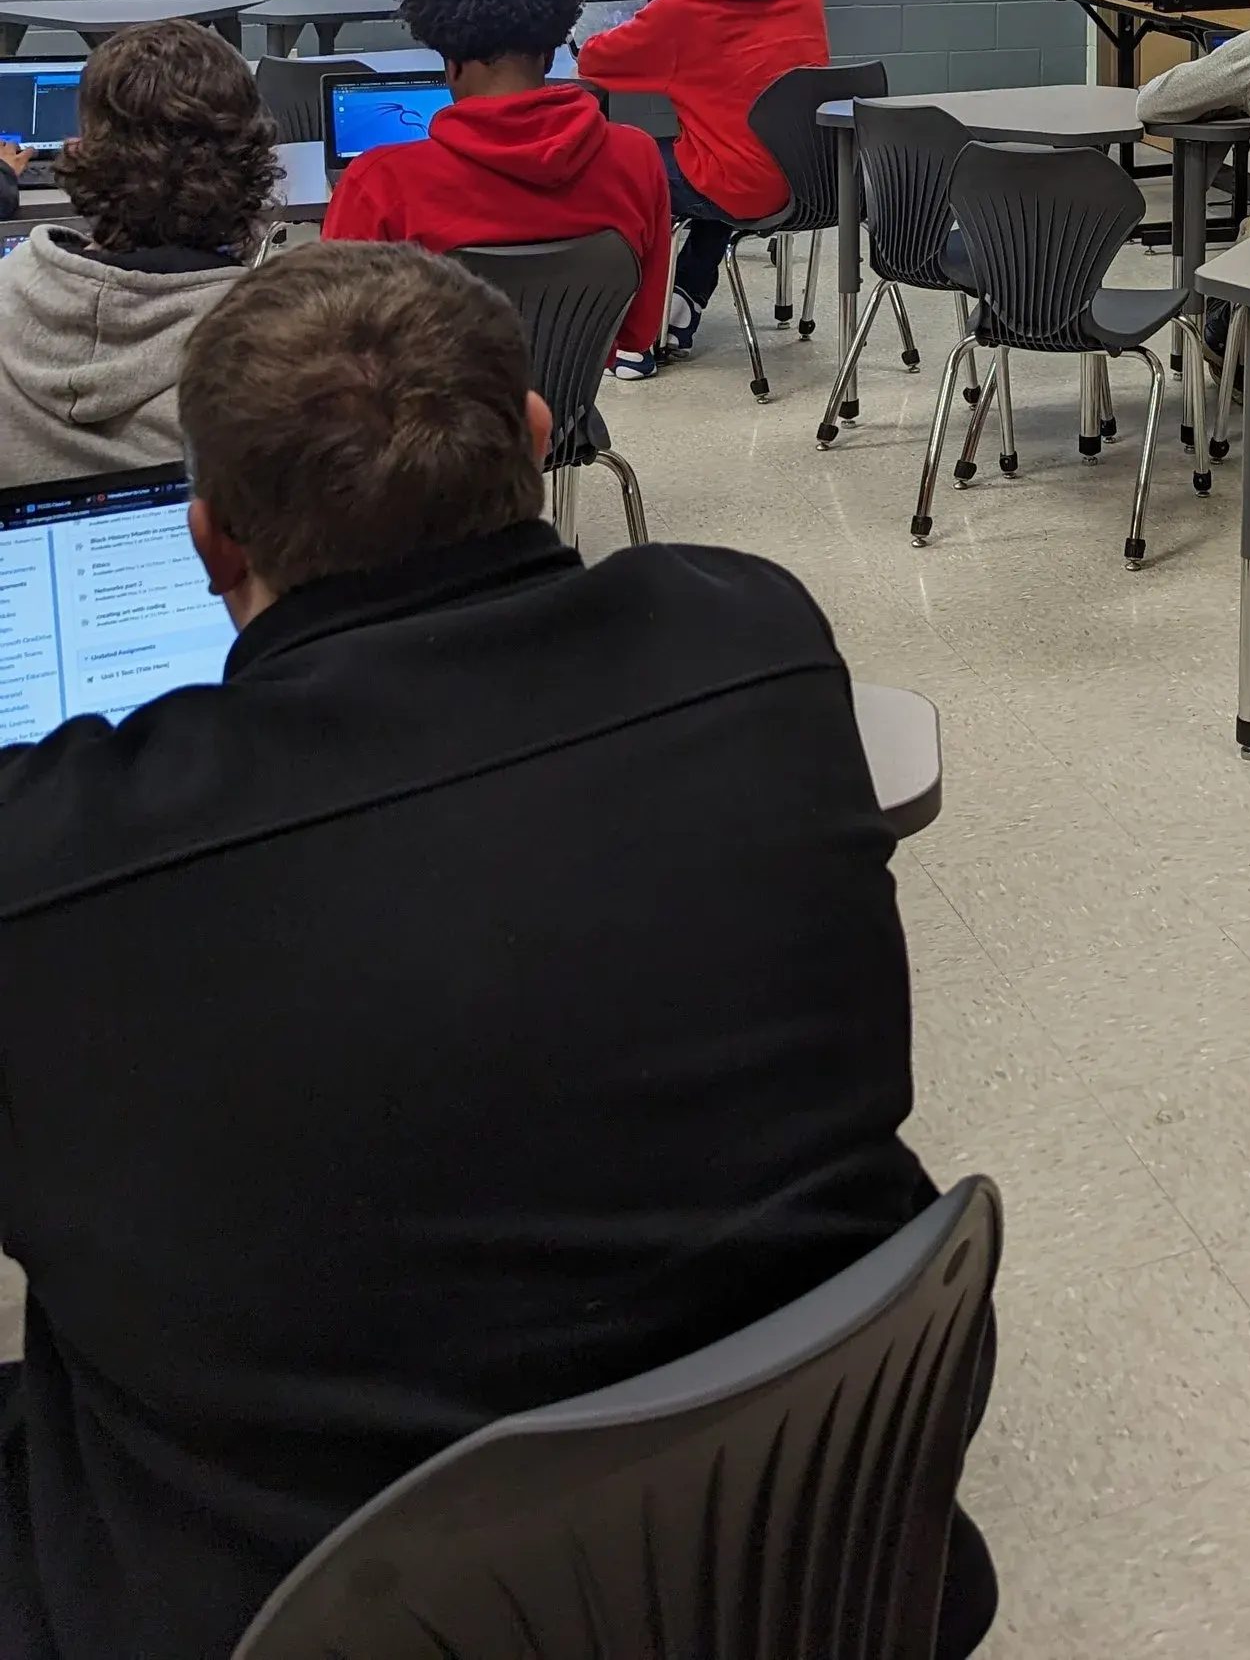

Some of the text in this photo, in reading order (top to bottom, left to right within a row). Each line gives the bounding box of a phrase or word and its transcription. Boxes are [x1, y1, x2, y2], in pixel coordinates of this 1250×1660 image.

[90, 537, 107, 545] Black
[108, 533, 130, 542] History
[131, 530, 152, 538] Month
[125, 582, 138, 591] part
[146, 602, 167, 611] coding
[118, 644, 156, 655] Assignments
